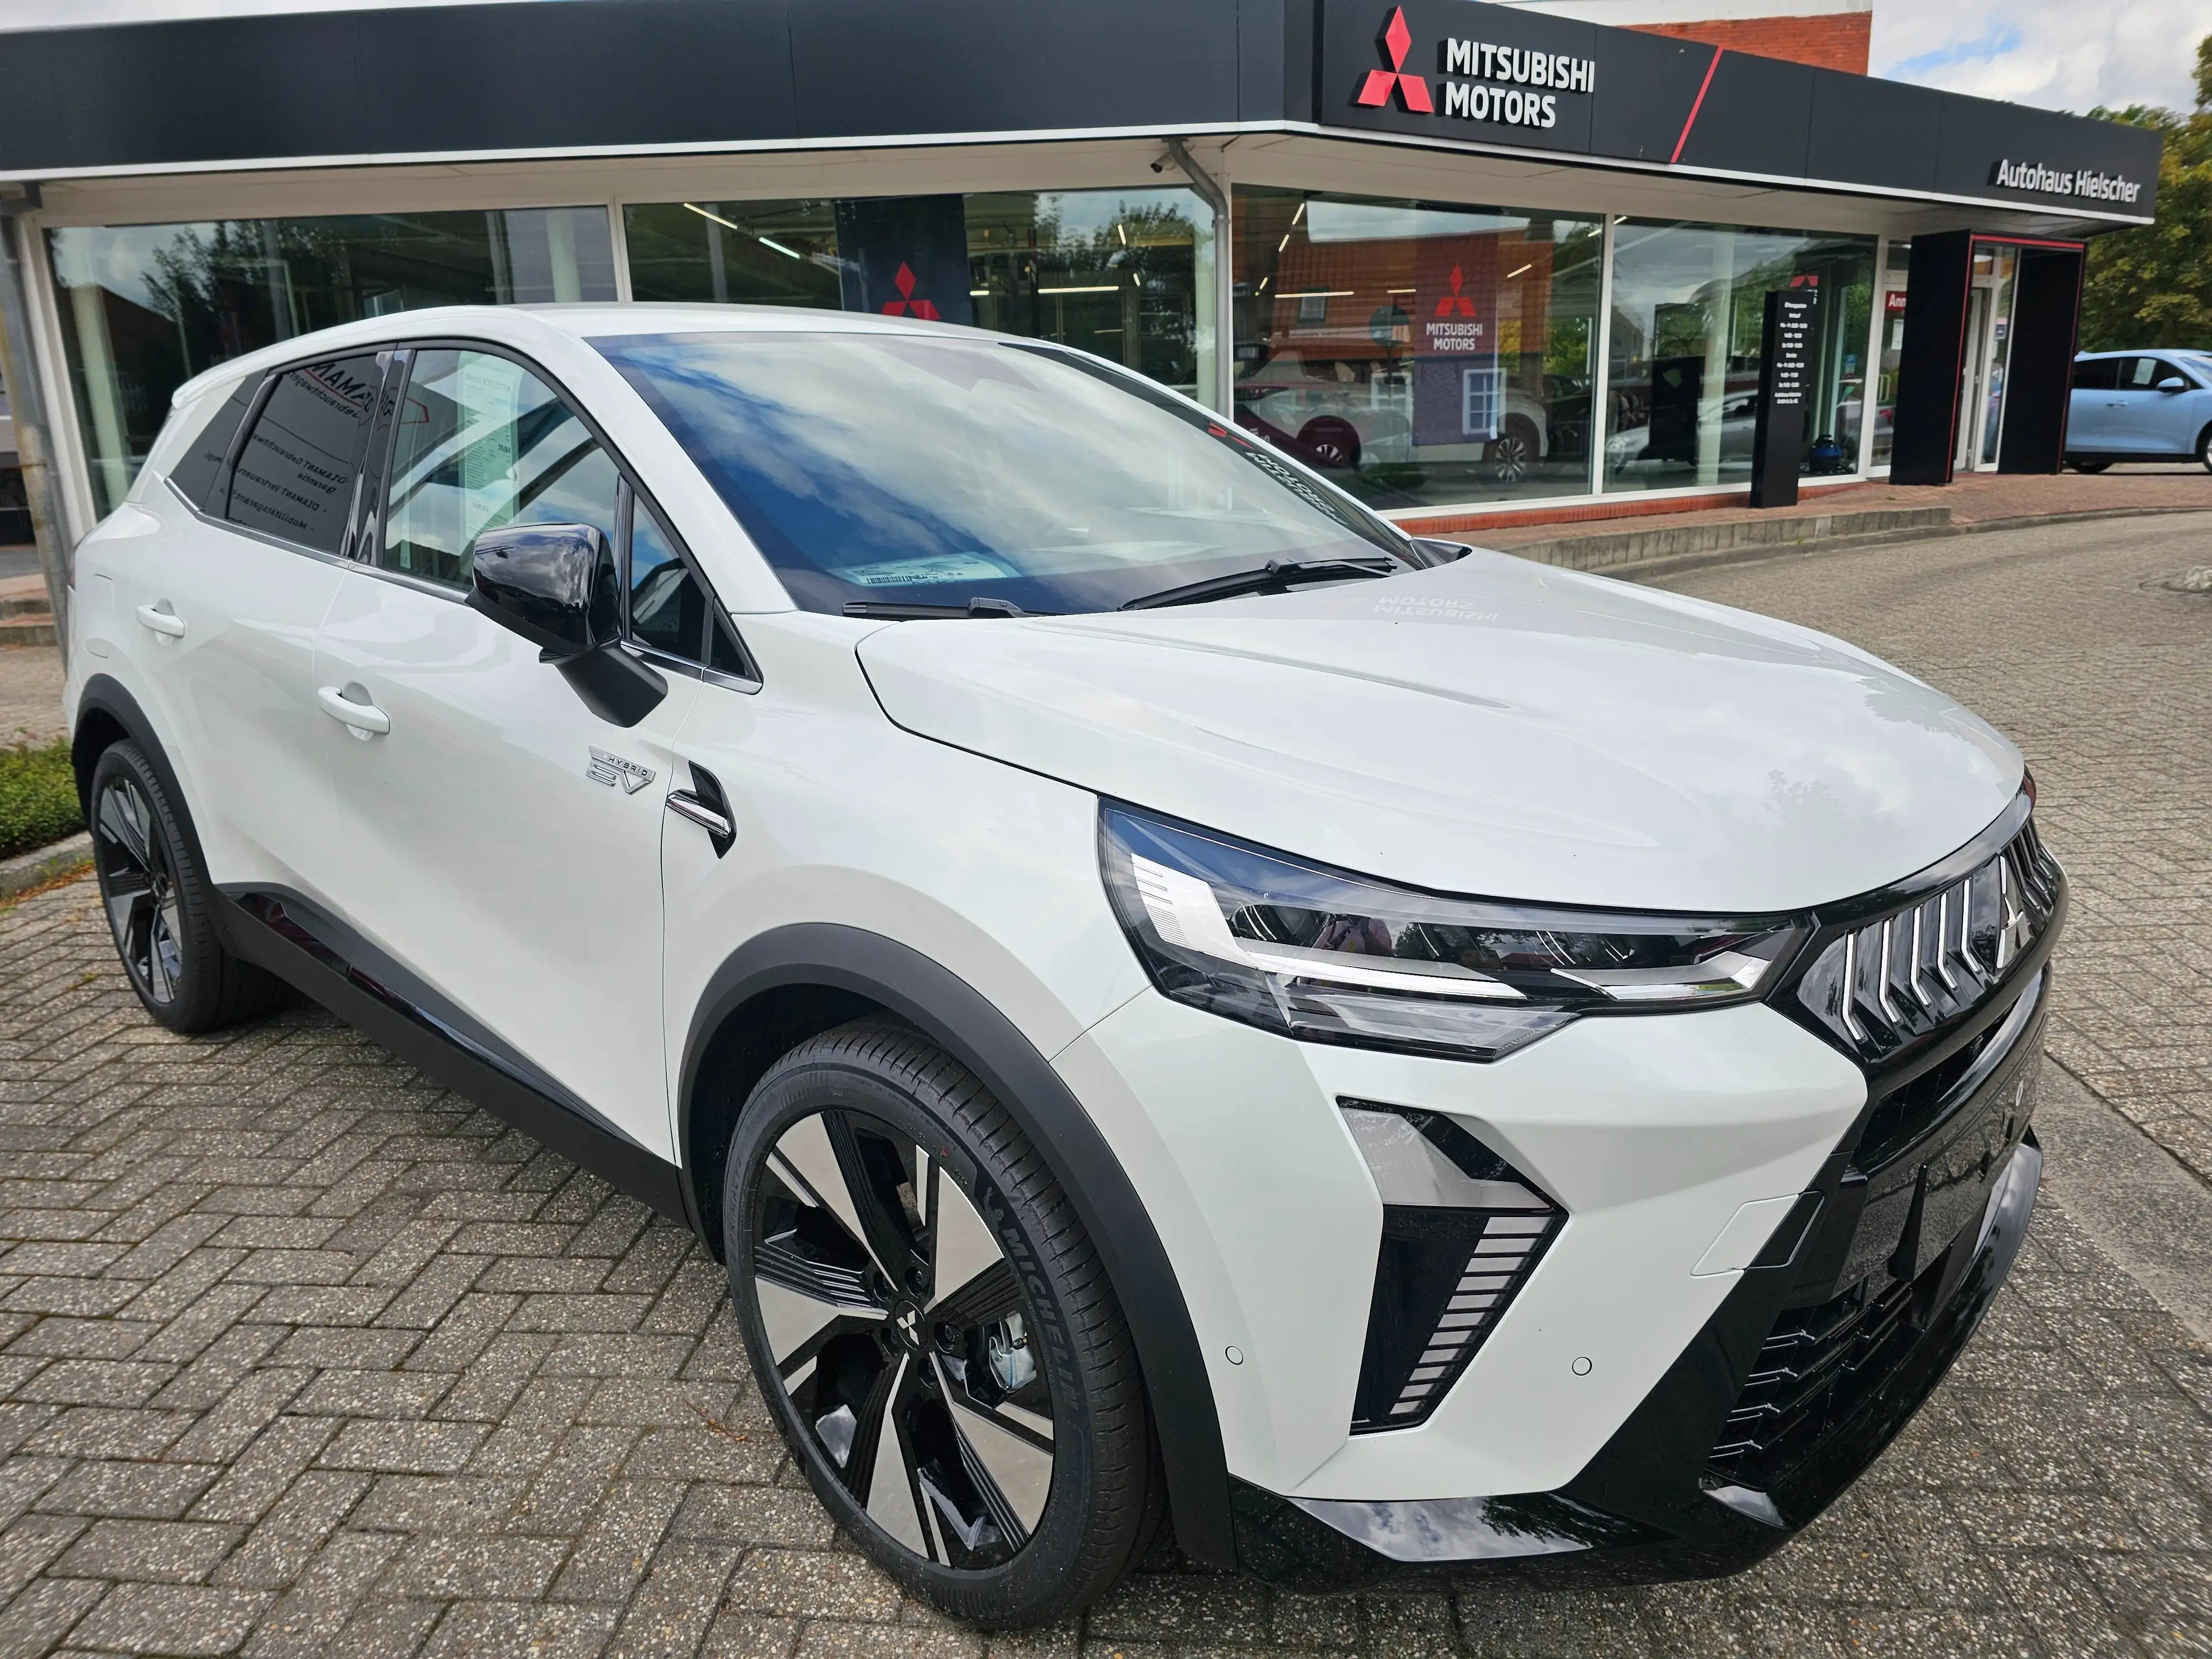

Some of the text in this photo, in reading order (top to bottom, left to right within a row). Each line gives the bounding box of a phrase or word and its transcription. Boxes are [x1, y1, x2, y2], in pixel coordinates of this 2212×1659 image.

[1446, 37, 1595, 93] MITSUBISHI
[1445, 82, 1555, 128] MOTORS
[1996, 158, 2141, 203] Autohaus Hielscher
[1426, 323, 1483, 336] MITSUBISHI
[1433, 338, 1475, 350] MOTORS
[608, 756, 648, 777] HYBRID
[1001, 1228, 1079, 1411] MICHELIN
